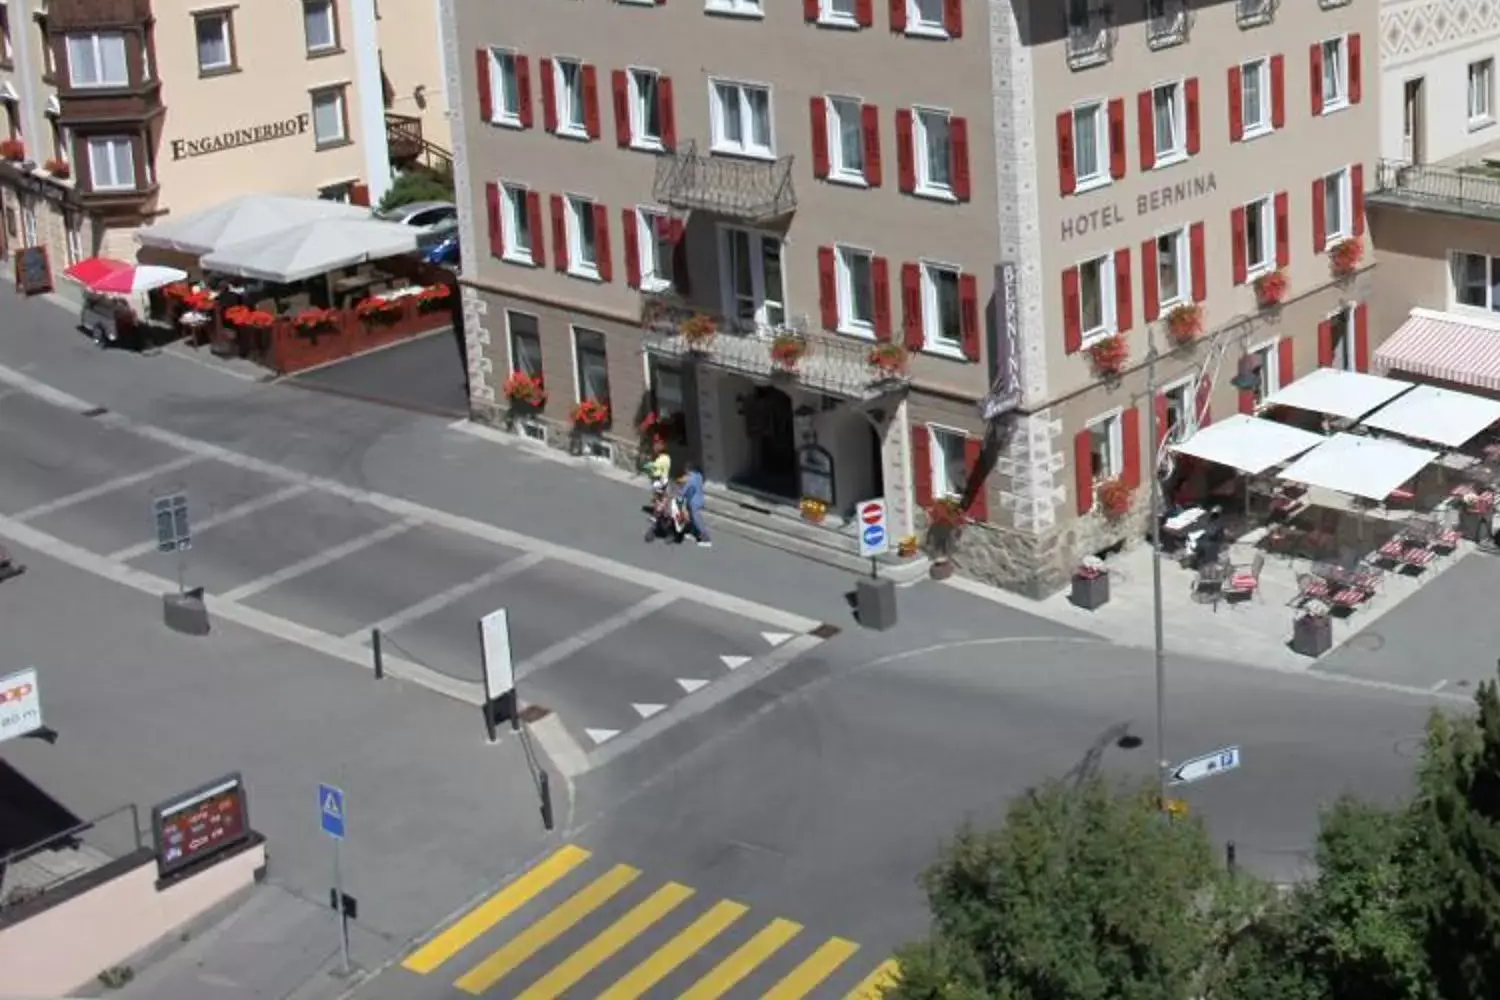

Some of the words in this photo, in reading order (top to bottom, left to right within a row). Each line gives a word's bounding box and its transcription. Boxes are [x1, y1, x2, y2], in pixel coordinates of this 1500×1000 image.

[170, 112, 309, 161] ENGADINERHOF
[1060, 203, 1125, 242] HOTEL
[1136, 171, 1217, 216] BERNINA
[1003, 265, 1021, 393] BERNINA
